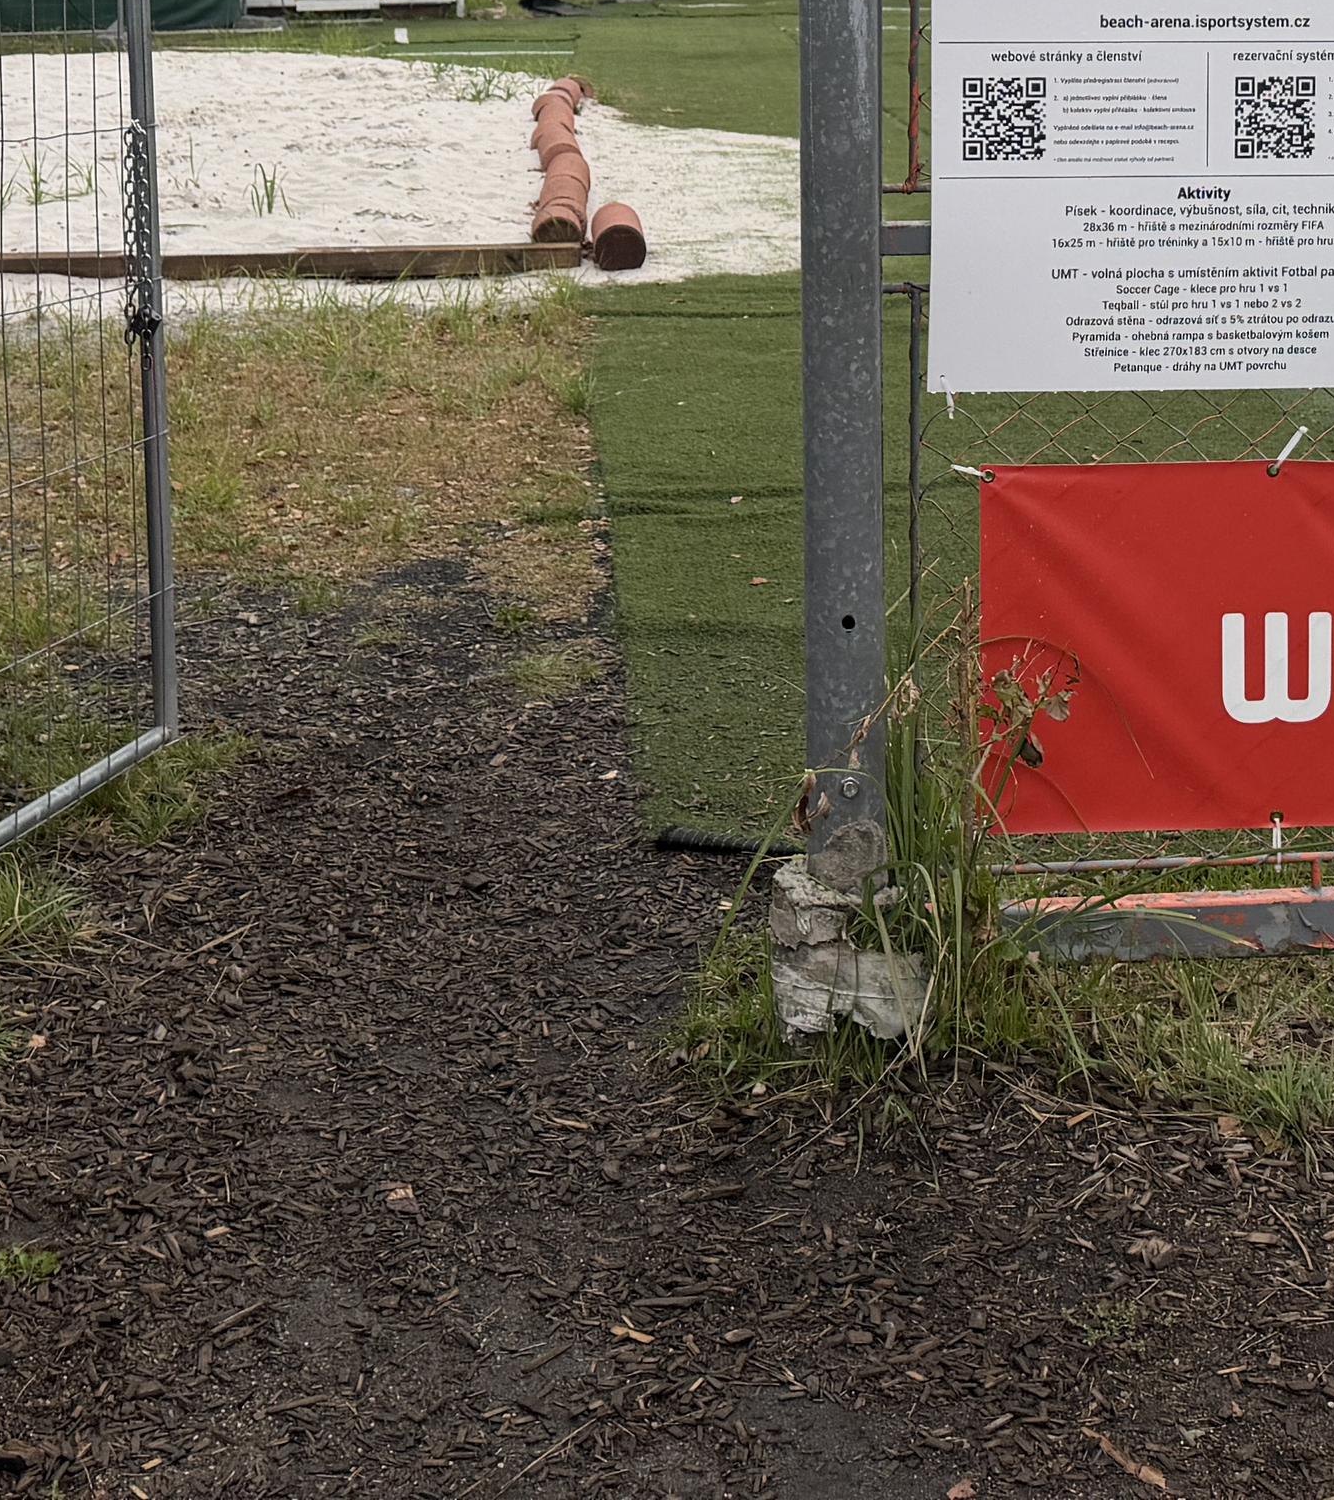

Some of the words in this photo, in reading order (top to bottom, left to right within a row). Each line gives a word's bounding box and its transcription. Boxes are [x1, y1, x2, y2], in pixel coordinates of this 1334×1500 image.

[1099, 15, 1311, 31] beach-arena.isportsystem.cz
[990, 51, 1036, 61] webové
[1039, 51, 1083, 64] stránky
[1086, 53, 1093, 61] a
[1096, 51, 1143, 61] členství
[1232, 50, 1294, 61] rezervační
[1177, 186, 1231, 202] Aktivity
[1065, 205, 1098, 216] Písek
[1109, 205, 1177, 217] koordinace,
[1179, 204, 1243, 217] výbušnost,
[1245, 204, 1269, 216] síla,
[1272, 204, 1290, 215] cit,
[1051, 269, 1079, 279] UMT
[1091, 268, 1123, 279] volná
[1125, 268, 1165, 280] plocha
[1167, 270, 1175, 278] s
[1177, 267, 1240, 278] umístěním
[1242, 267, 1278, 277] aktivit
[1281, 266, 1318, 277] Fotbal
[1113, 363, 1162, 373] Petanque
[1172, 361, 1202, 373] dráhy
[1219, 361, 1244, 370] UMT
[1245, 360, 1287, 372] povrchu
